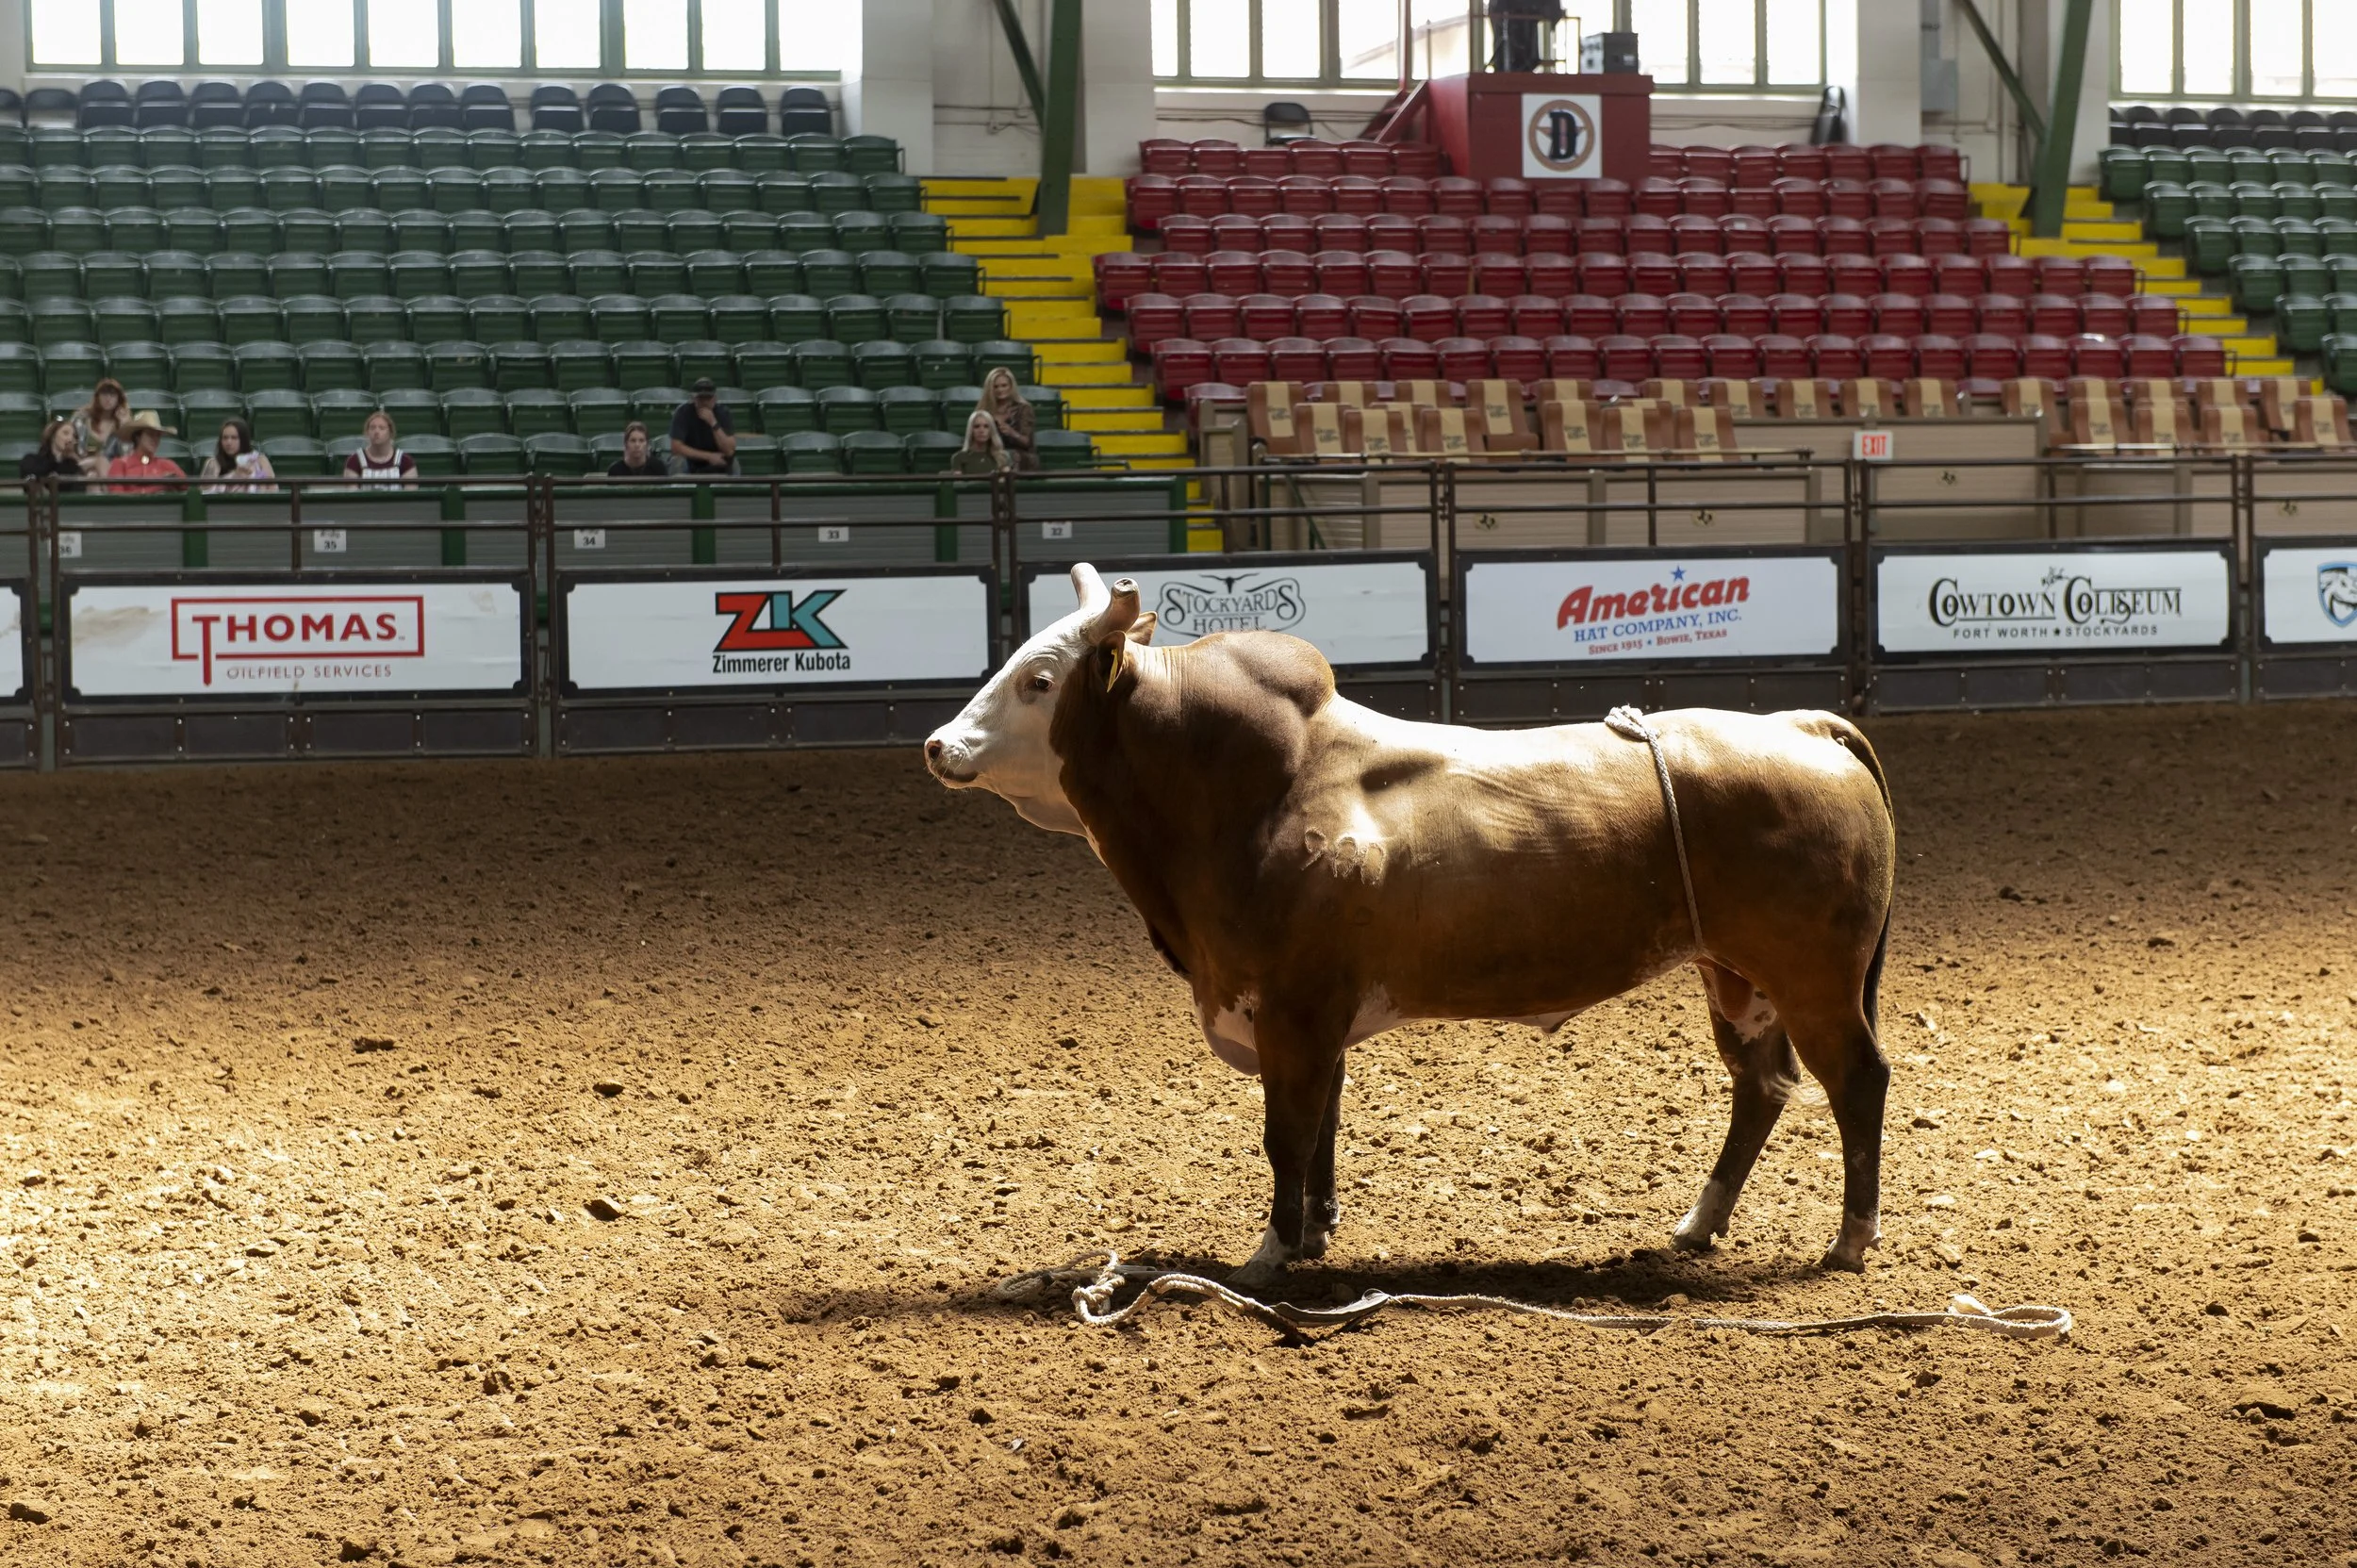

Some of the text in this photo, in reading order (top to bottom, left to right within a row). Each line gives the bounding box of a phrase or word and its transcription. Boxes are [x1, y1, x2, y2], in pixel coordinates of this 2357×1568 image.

[1862, 435, 1887, 456] EXIT
[583, 536, 596, 546] 34
[1164, 585, 1297, 626] STOCKYARDS
[1557, 575, 1750, 631] American
[1929, 575, 2183, 627] COWTOWN COLISEUM
[713, 588, 849, 652] ZK
[1574, 608, 1742, 643] HAT COMPANY, INC.
[1953, 624, 2159, 639] FORT WORTH STOCKYARDS
[191, 613, 398, 686] THOMAS
[1621, 638, 1643, 652] 1915
[226, 663, 392, 681] OILFIELD SERVICES
[713, 652, 850, 674] Zimmerer Kubota
